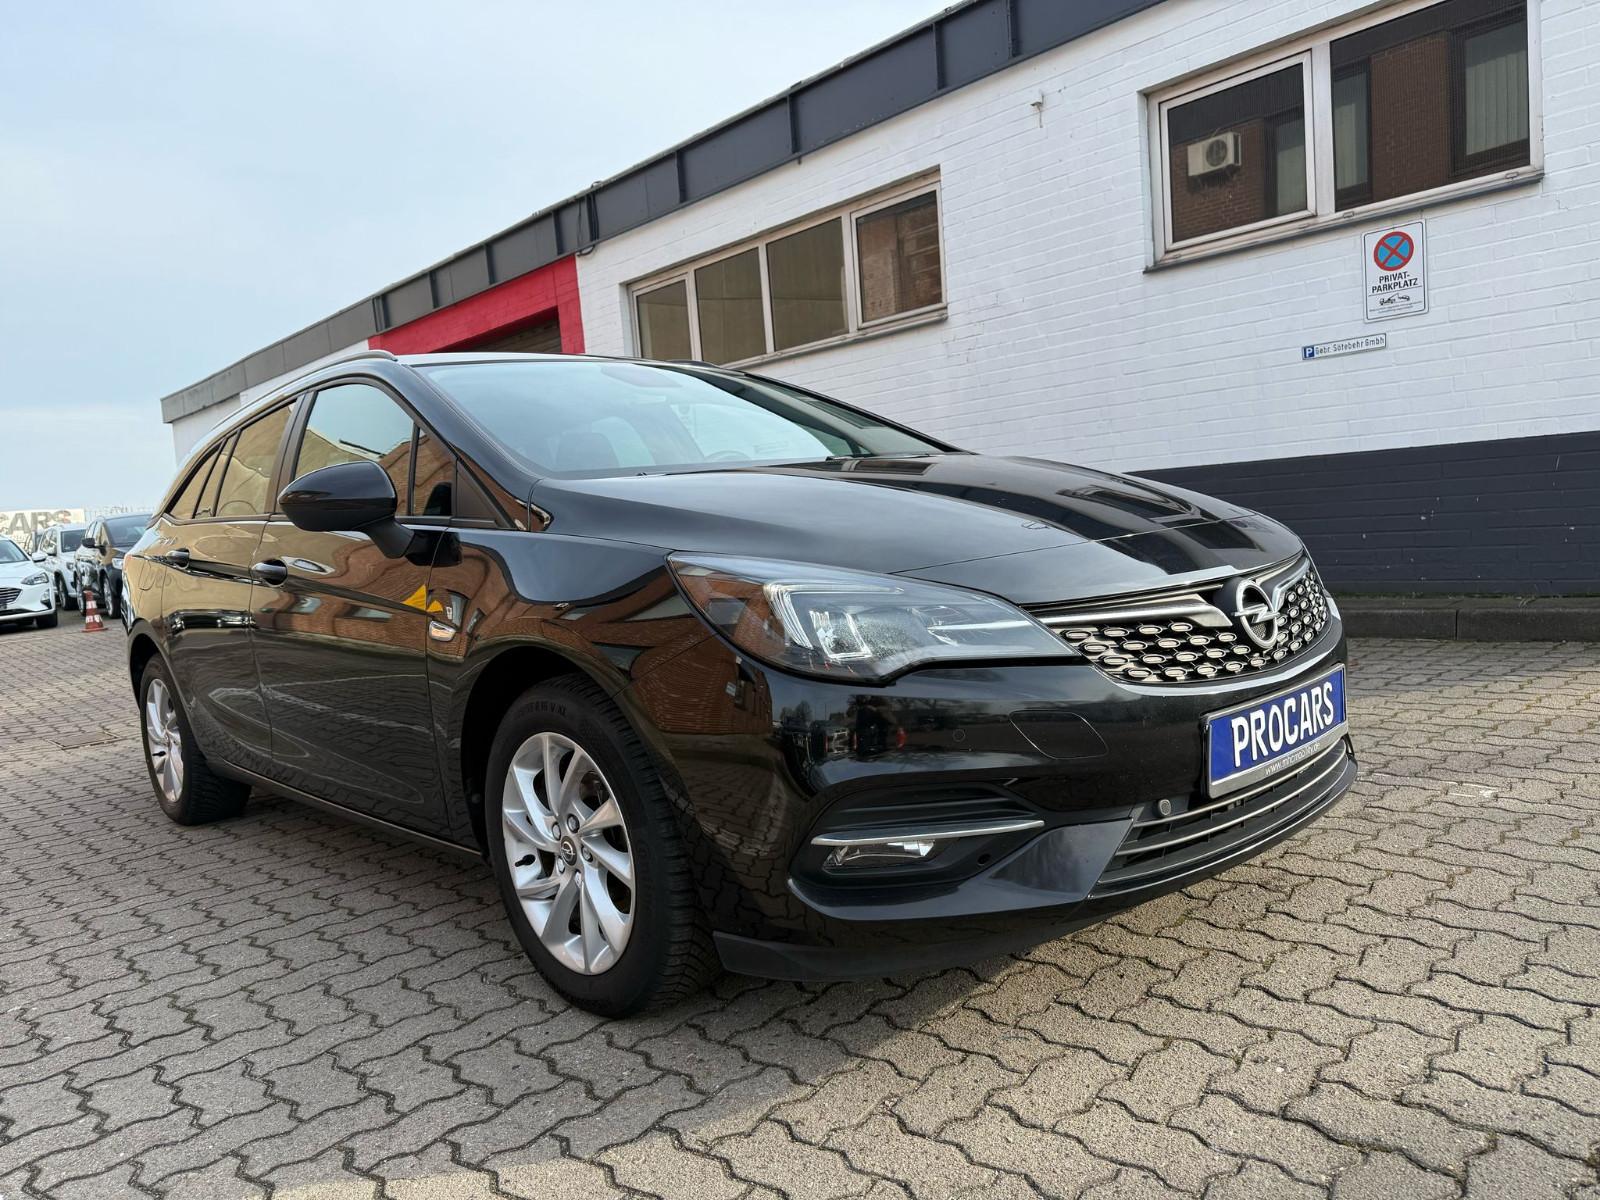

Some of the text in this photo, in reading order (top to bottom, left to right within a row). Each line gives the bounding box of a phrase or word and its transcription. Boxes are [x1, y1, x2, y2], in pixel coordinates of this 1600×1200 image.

[1379, 271, 1410, 284] PRIVAT-
[1372, 278, 1418, 294] PARKPLATZ
[1305, 347, 1314, 358] P
[1231, 681, 1334, 768] PROCARS
